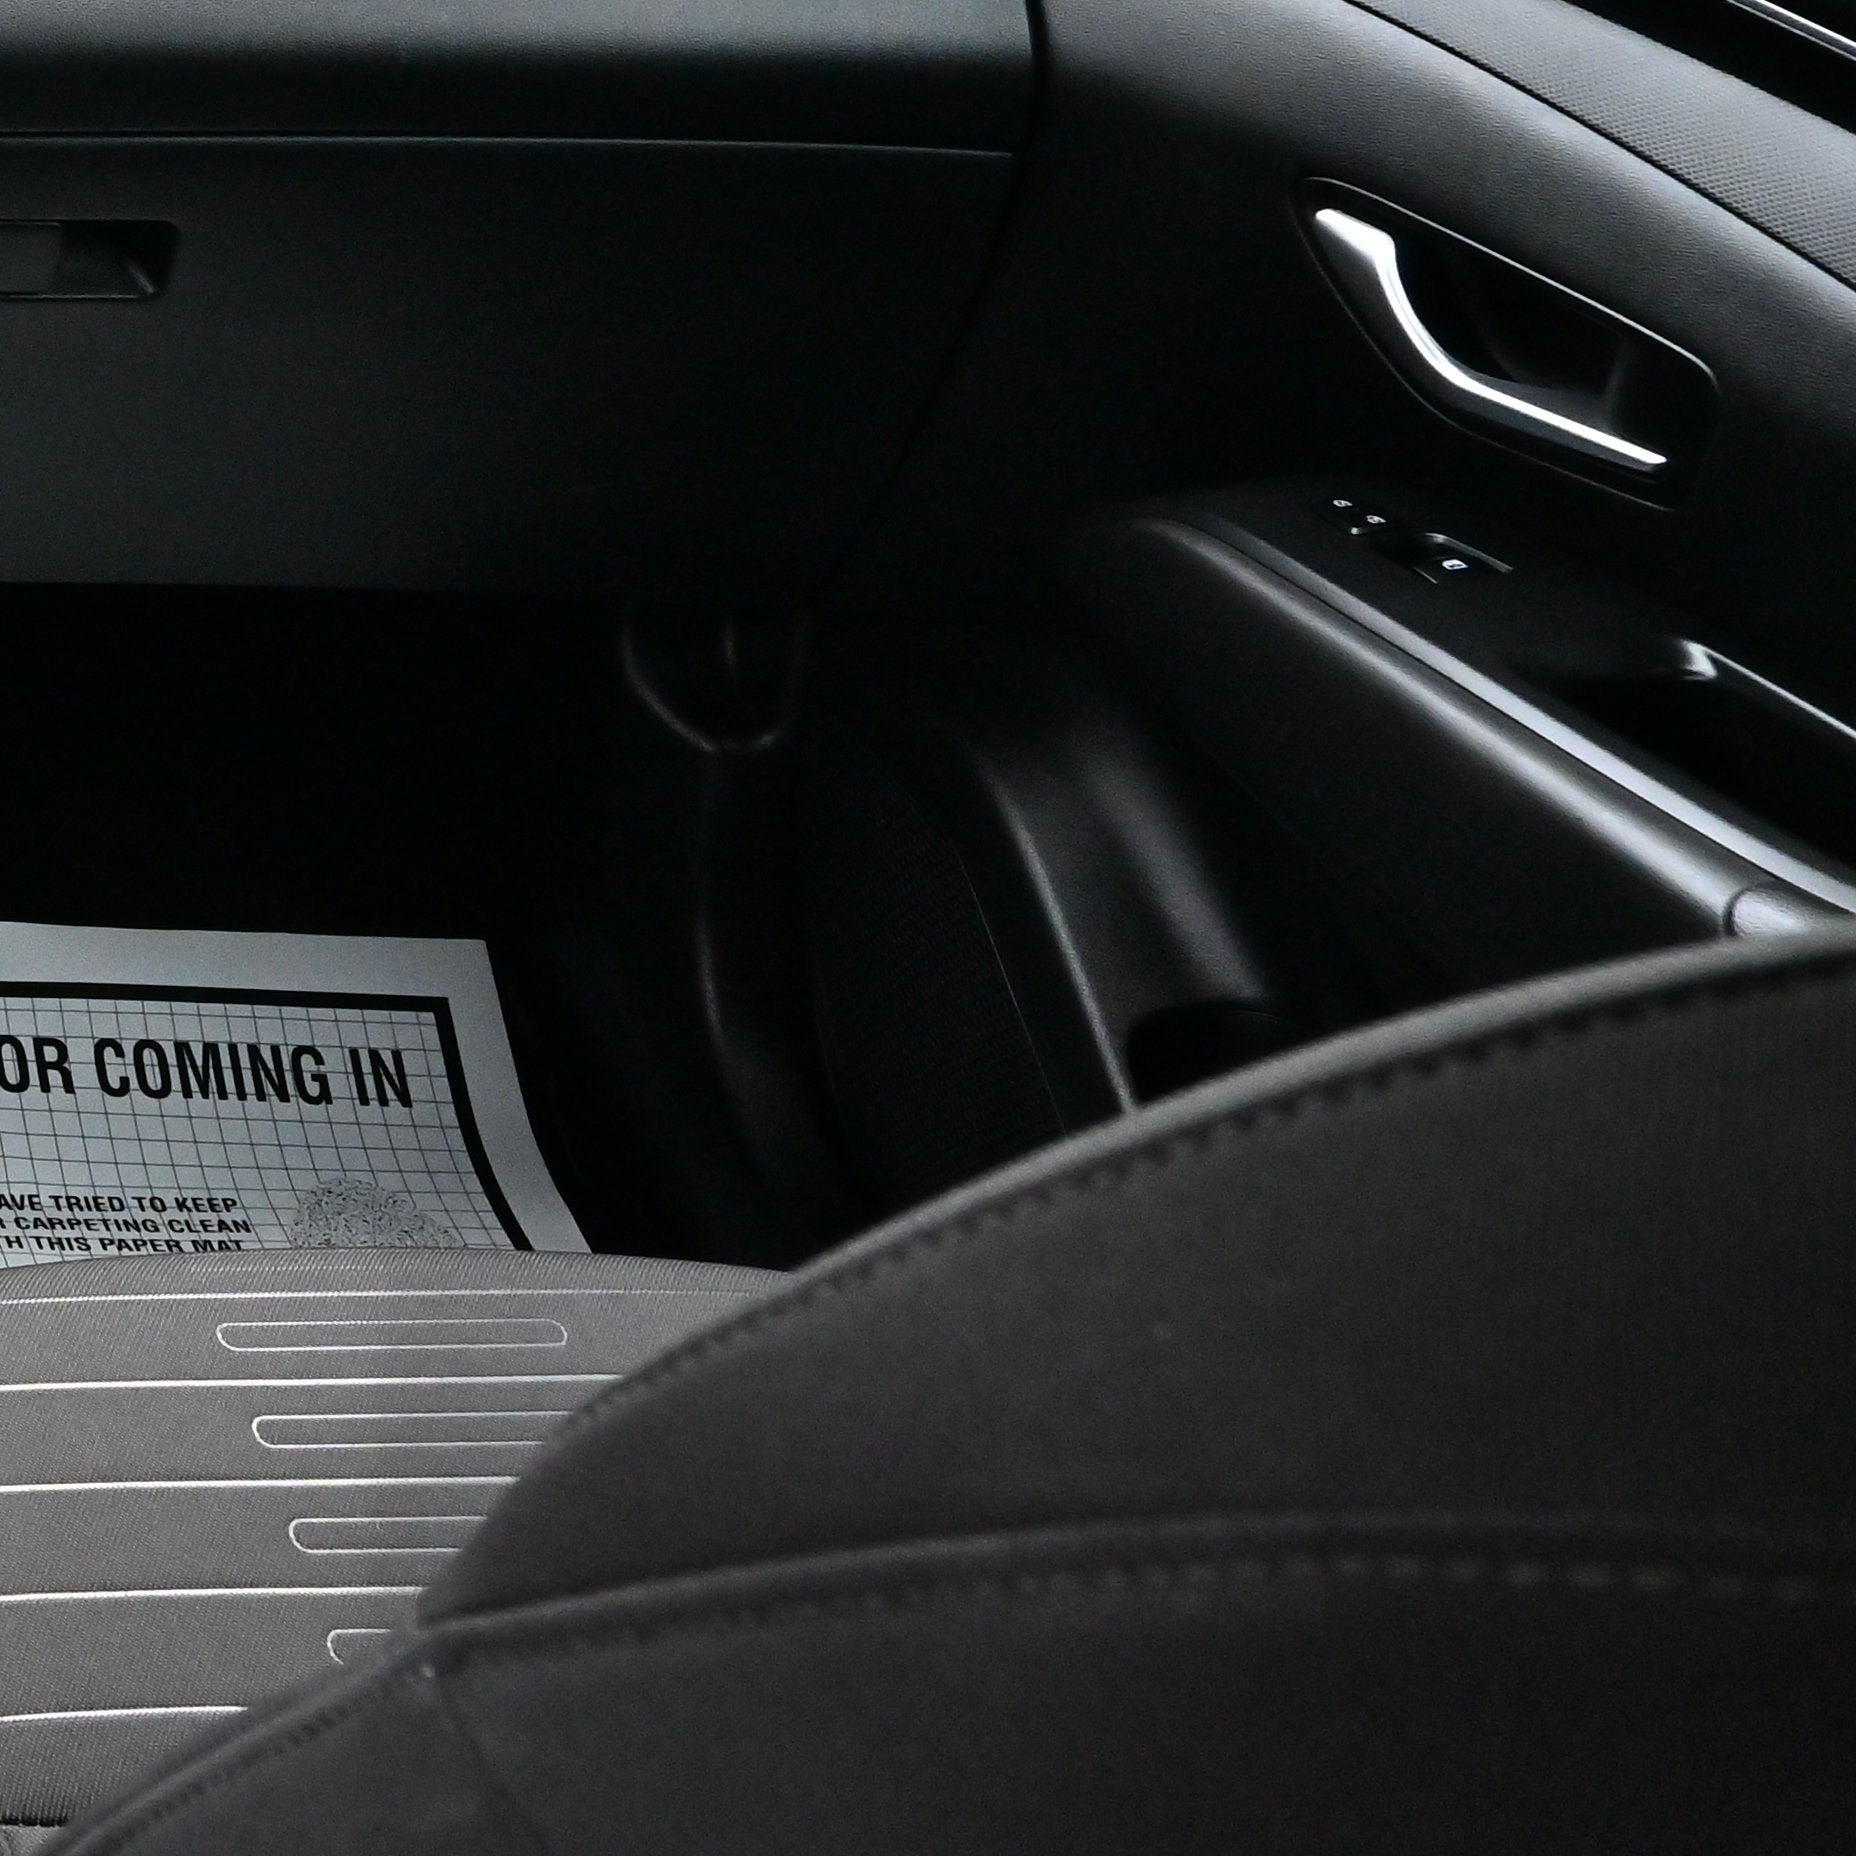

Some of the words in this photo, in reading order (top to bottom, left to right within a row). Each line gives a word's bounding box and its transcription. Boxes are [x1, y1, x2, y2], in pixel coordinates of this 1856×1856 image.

[95, 1038, 333, 1106] COMING
[350, 1047, 414, 1108] IN
[48, 1194, 126, 1214] TRIED
[132, 1196, 167, 1214] TO
[173, 1197, 238, 1214] KEEP
[14, 1216, 160, 1233] CARPETING
[168, 1218, 253, 1234] CLEAN
[32, 1235, 93, 1252] THIS
[101, 1237, 185, 1253] PAPER
[191, 1238, 244, 1253] MAT
